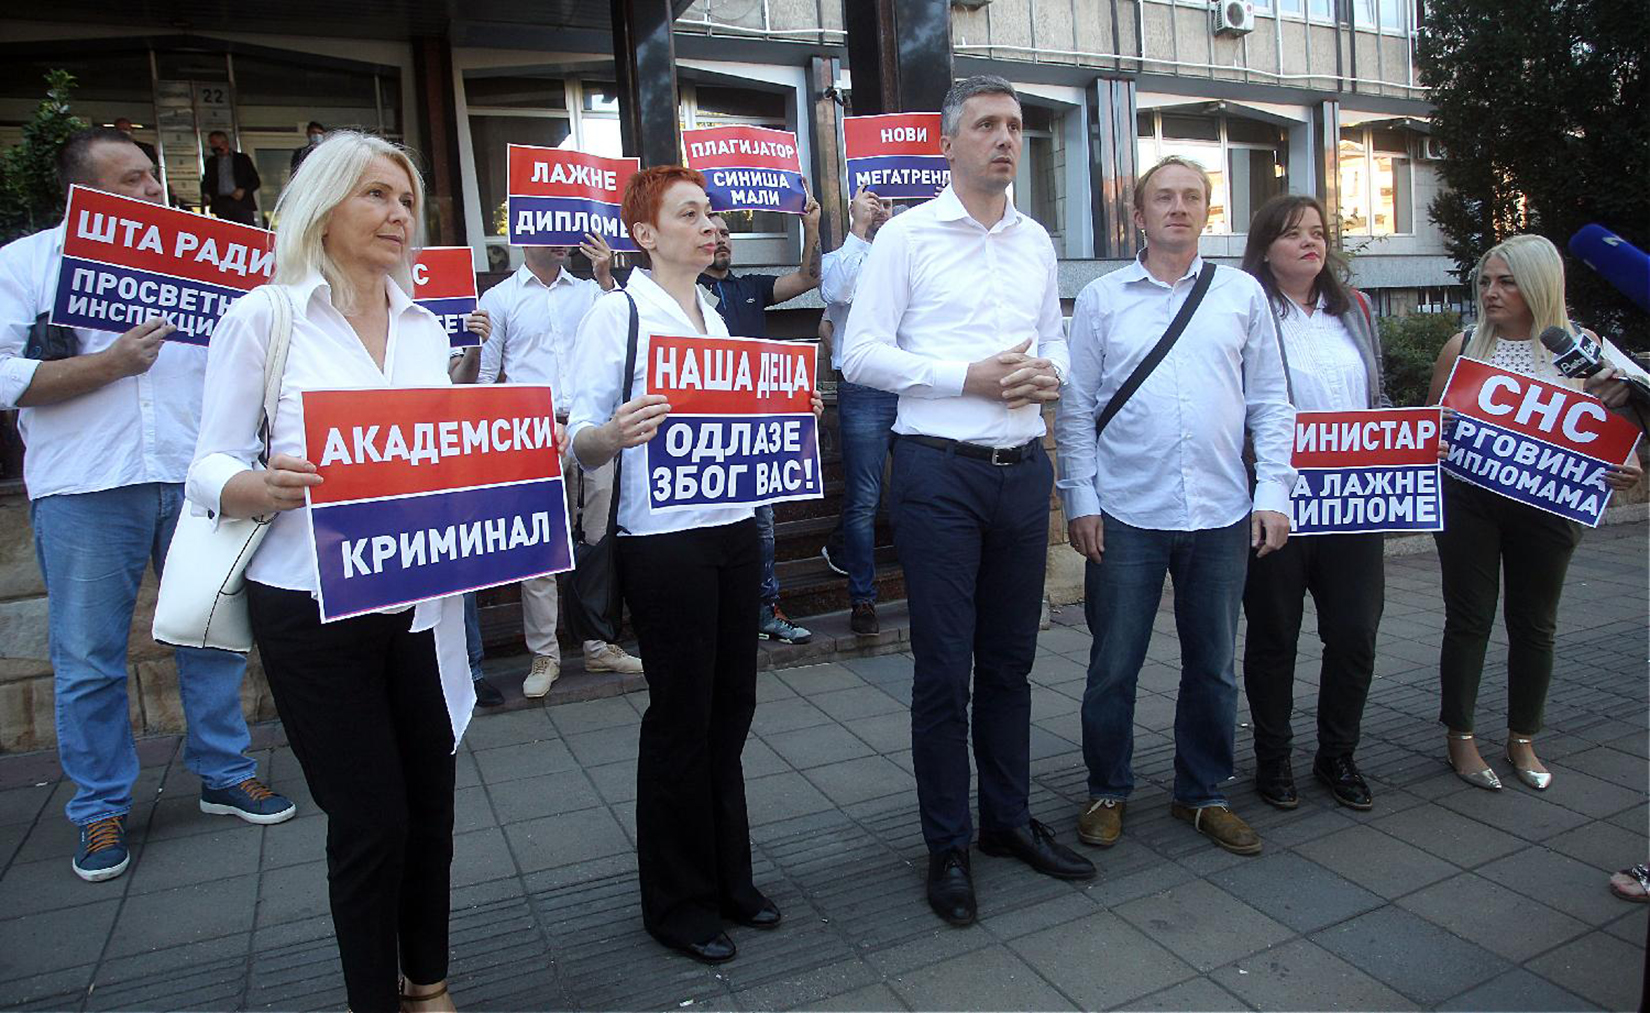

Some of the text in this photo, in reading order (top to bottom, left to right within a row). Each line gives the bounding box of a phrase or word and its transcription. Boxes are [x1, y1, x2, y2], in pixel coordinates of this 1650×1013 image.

[203, 89, 224, 104] 22
[691, 140, 795, 159] ПЛАГИЈАТОР
[880, 127, 927, 143] НОВИ
[531, 162, 616, 191] ЛАЖНЕ
[713, 171, 790, 189] СИНИША
[856, 169, 951, 187] МЕГАТРЕНД
[732, 190, 780, 206] МАЛИ
[77, 210, 275, 278] ШТА РАДИ
[655, 347, 810, 399] НАША ДЕЦА
[1478, 374, 1607, 443] СНС
[320, 416, 553, 467] АКАДЕМСКИ
[666, 421, 801, 463] ОДЛАЗЕ
[1296, 420, 1437, 453] ИНИСТАР
[1453, 420, 1607, 492] РГОВИНА
[652, 458, 813, 502] ЗБОГ ВАС!
[1319, 470, 1437, 497] ЛАЖНЕ
[1447, 443, 1598, 517] ИПЛОМАМА
[341, 511, 550, 579] КРИМИНАЛ
